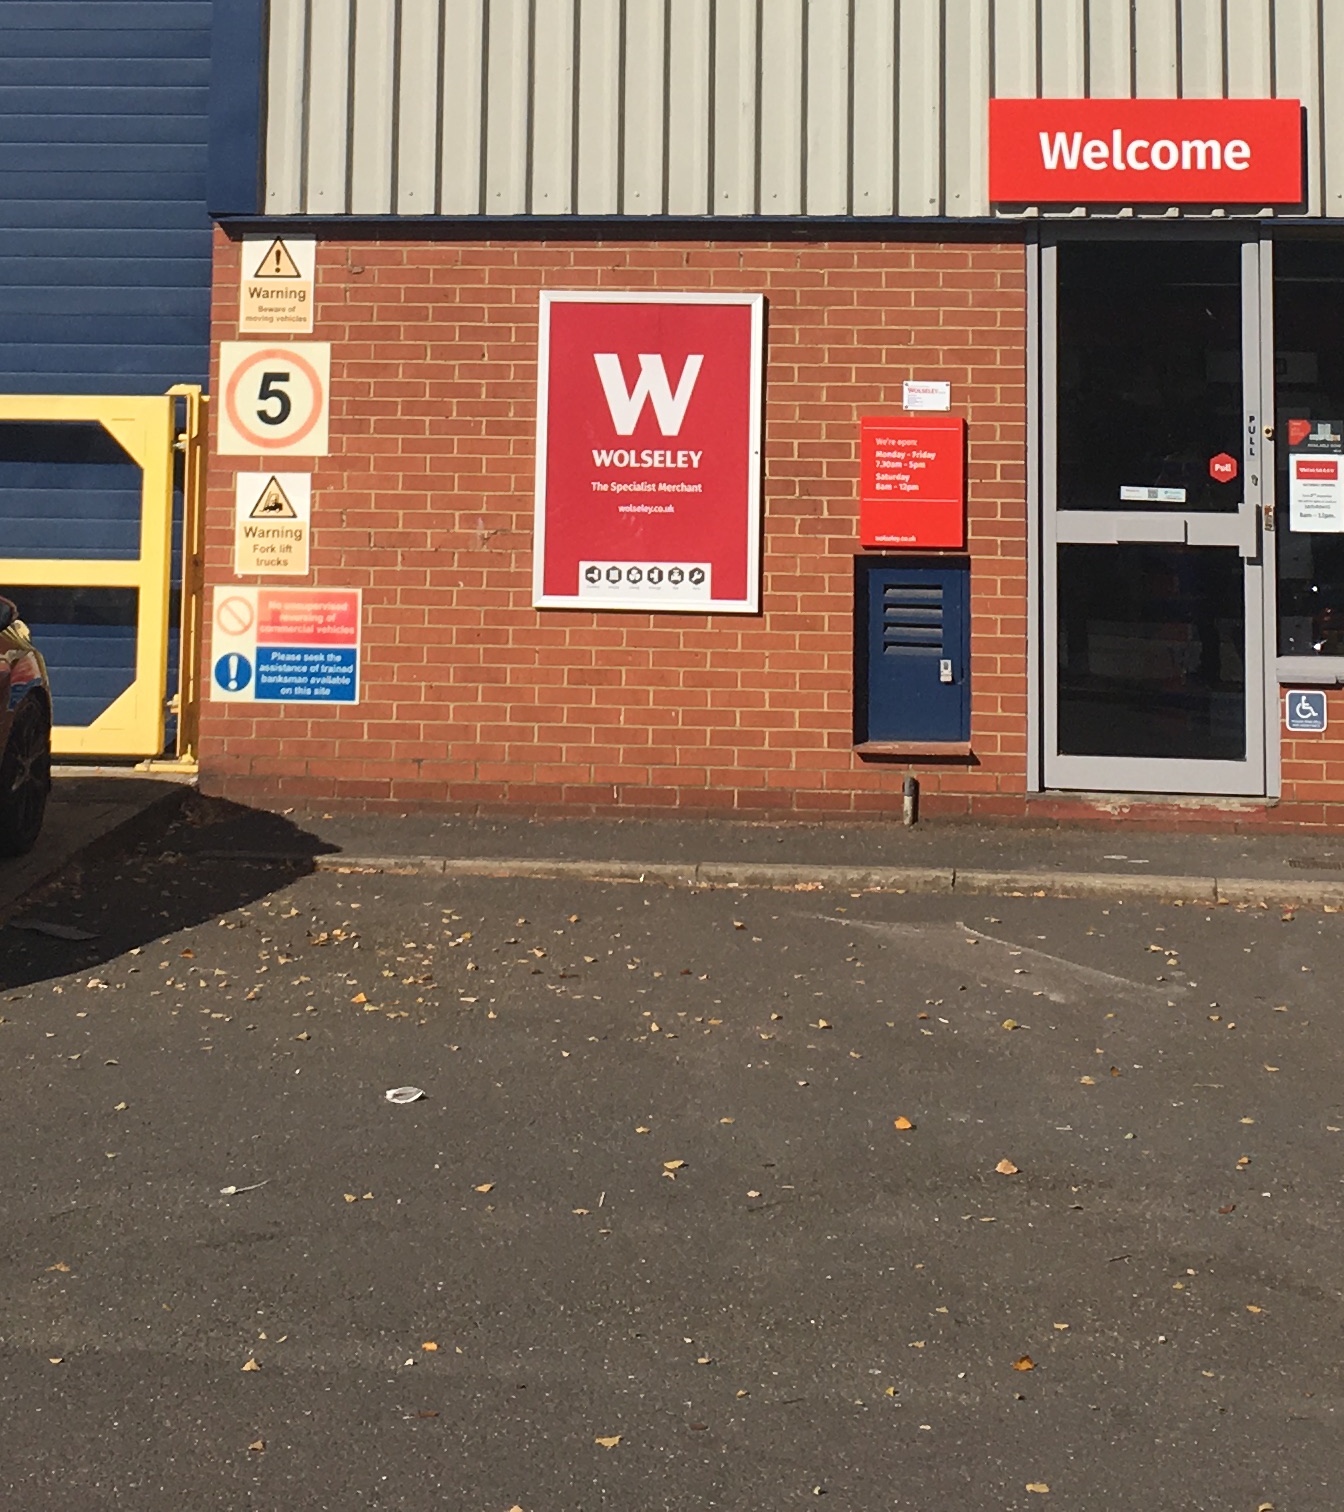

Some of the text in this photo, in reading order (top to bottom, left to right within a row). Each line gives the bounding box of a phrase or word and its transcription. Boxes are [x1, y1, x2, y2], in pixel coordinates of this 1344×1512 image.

[1039, 128, 1251, 171] Welcome
[248, 287, 306, 302] Warning
[258, 305, 296, 313] Beware of
[245, 315, 307, 323] moving vehicles
[256, 372, 291, 426] 5
[593, 353, 704, 437] W
[875, 438, 896, 446] We're
[592, 449, 703, 468] WOLSELEY
[875, 450, 906, 460] Monday
[912, 450, 936, 460] Friday
[875, 460, 902, 468] 7.30am
[909, 461, 926, 470] 5pm
[1215, 463, 1231, 472] Pull
[875, 473, 910, 482] Saturday
[591, 481, 702, 493] The Specialist Merchant
[899, 483, 919, 492] 12pm
[618, 504, 675, 514] wolseley.co.uk
[244, 526, 303, 541] Warning
[253, 544, 293, 553] Fork lift
[256, 557, 288, 567] trucks
[268, 601, 348, 611] No unsupervised
[326, 613, 336, 622] of
[259, 625, 355, 635] commercial vehicles
[271, 651, 342, 662] Please seek the
[259, 663, 354, 673] assistance of trained
[261, 674, 351, 685] banksman available
[280, 686, 331, 696] on this site
